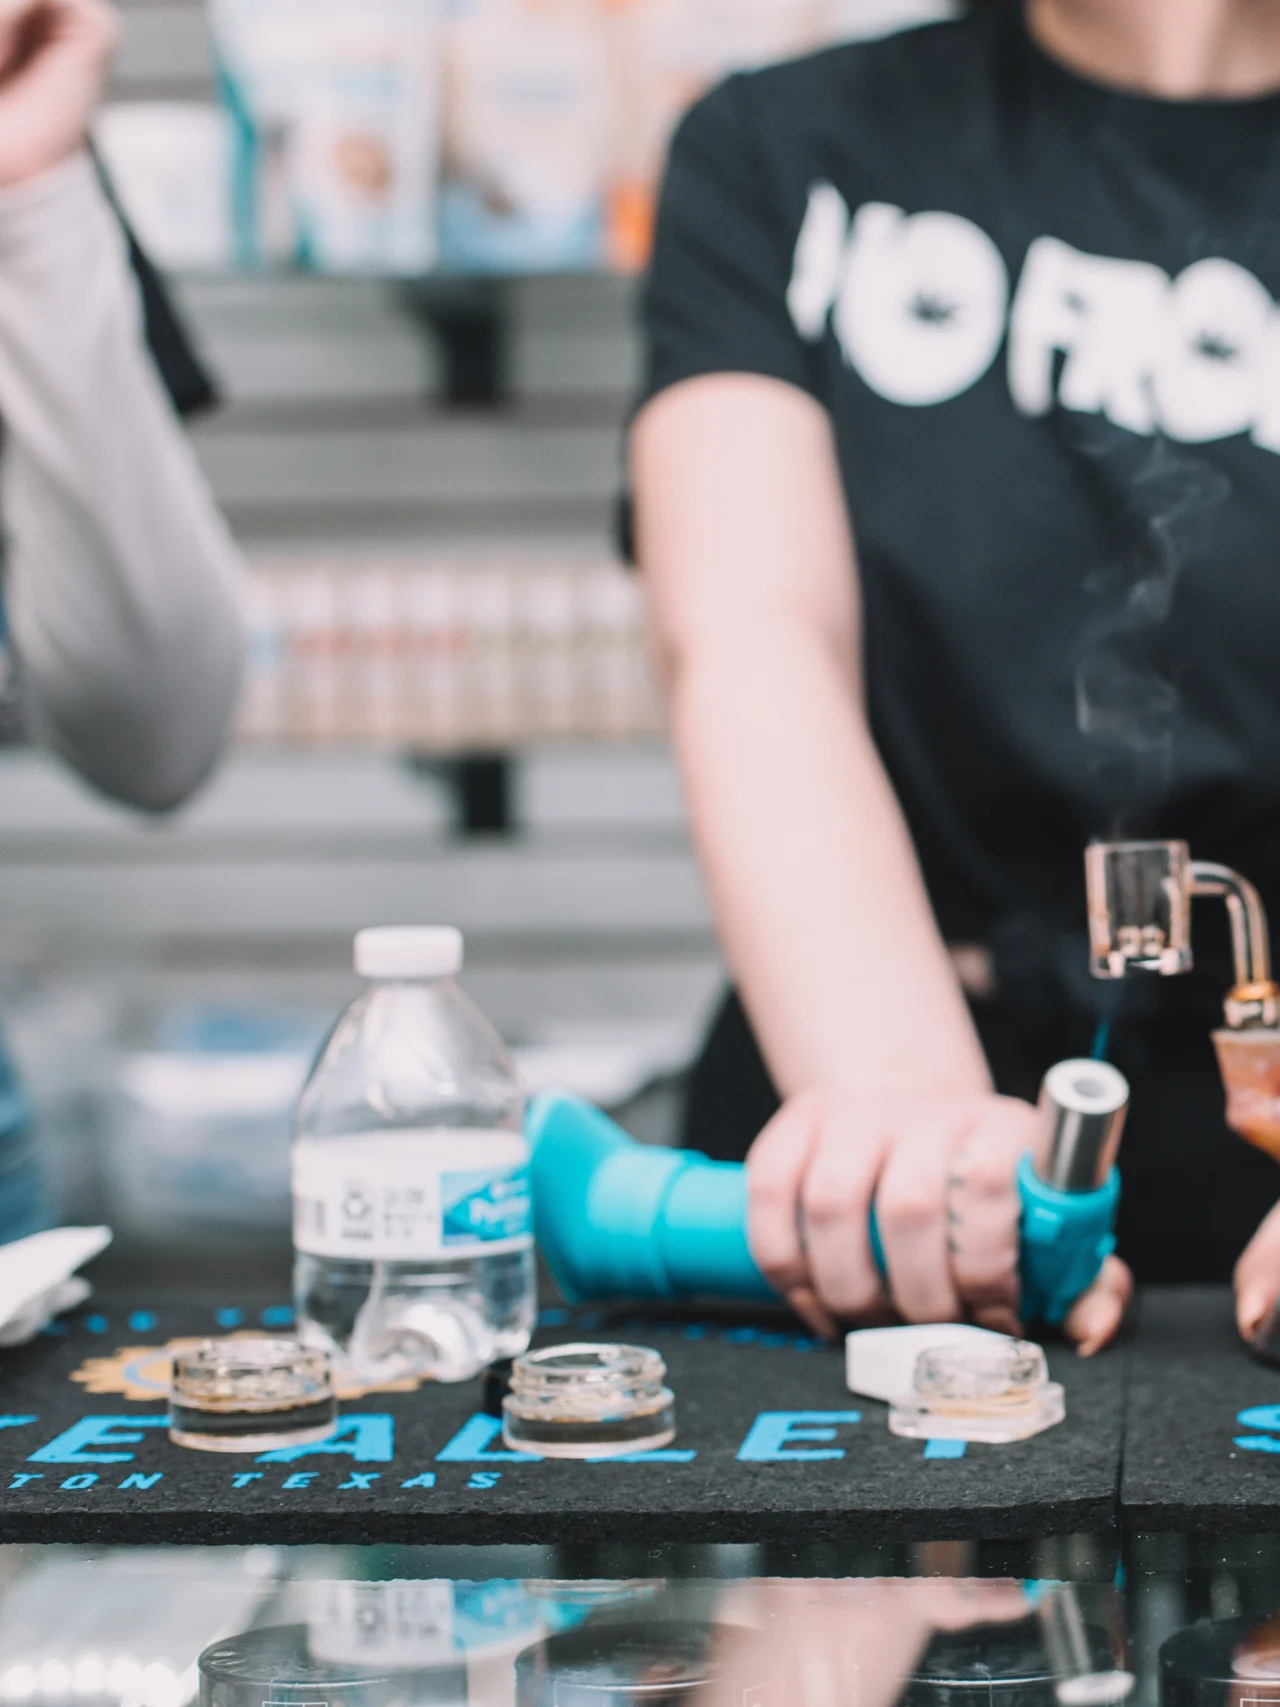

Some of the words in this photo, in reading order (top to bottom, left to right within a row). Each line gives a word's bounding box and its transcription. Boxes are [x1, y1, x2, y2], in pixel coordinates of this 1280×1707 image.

[0, 1413, 172, 1463] E
[255, 1411, 967, 1463] ALE
[230, 1471, 502, 1490] TEXAS
